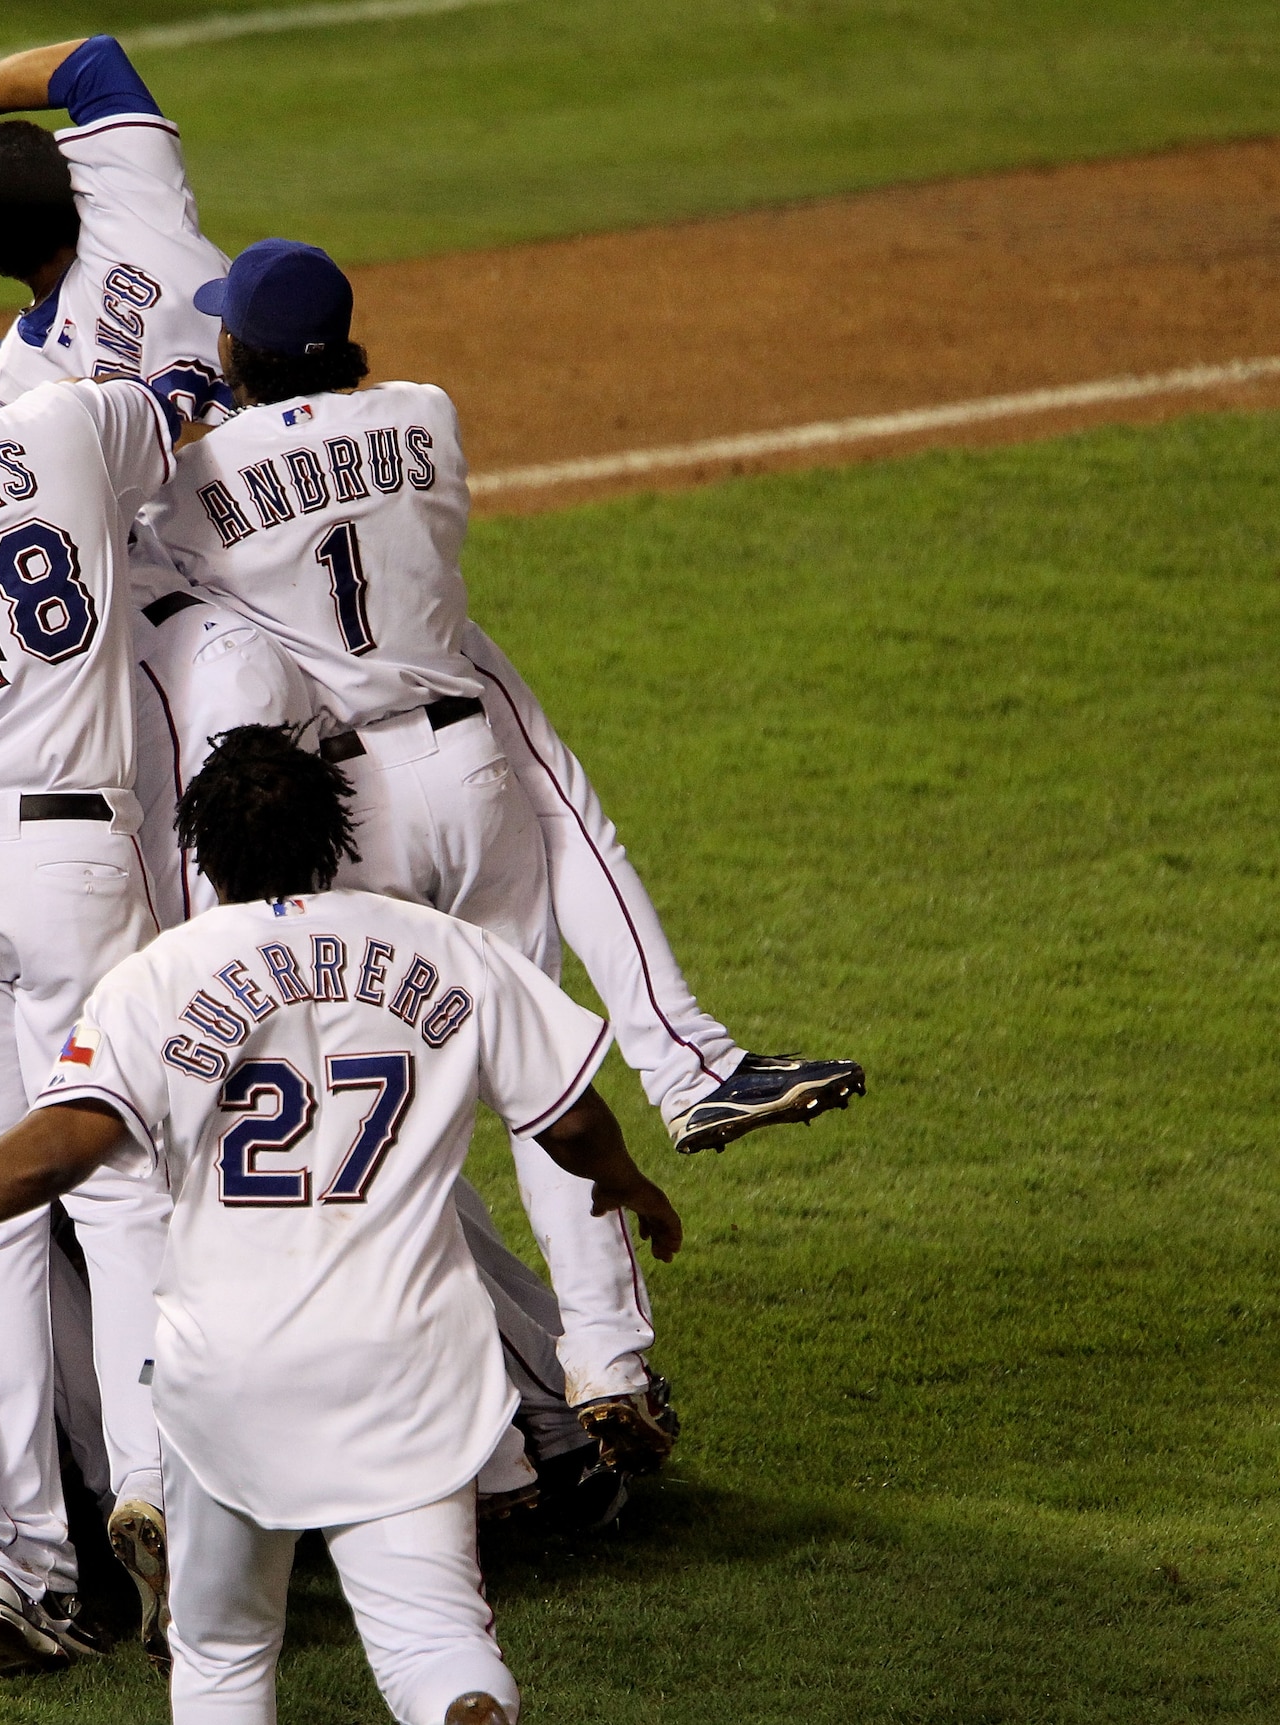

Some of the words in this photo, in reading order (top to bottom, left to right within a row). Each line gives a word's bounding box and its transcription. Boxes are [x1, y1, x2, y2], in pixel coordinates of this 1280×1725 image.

[197, 425, 435, 549] ANDRUS
[314, 519, 377, 657] 1
[161, 934, 473, 1083] GUERRERO
[214, 1050, 414, 1207] 27
